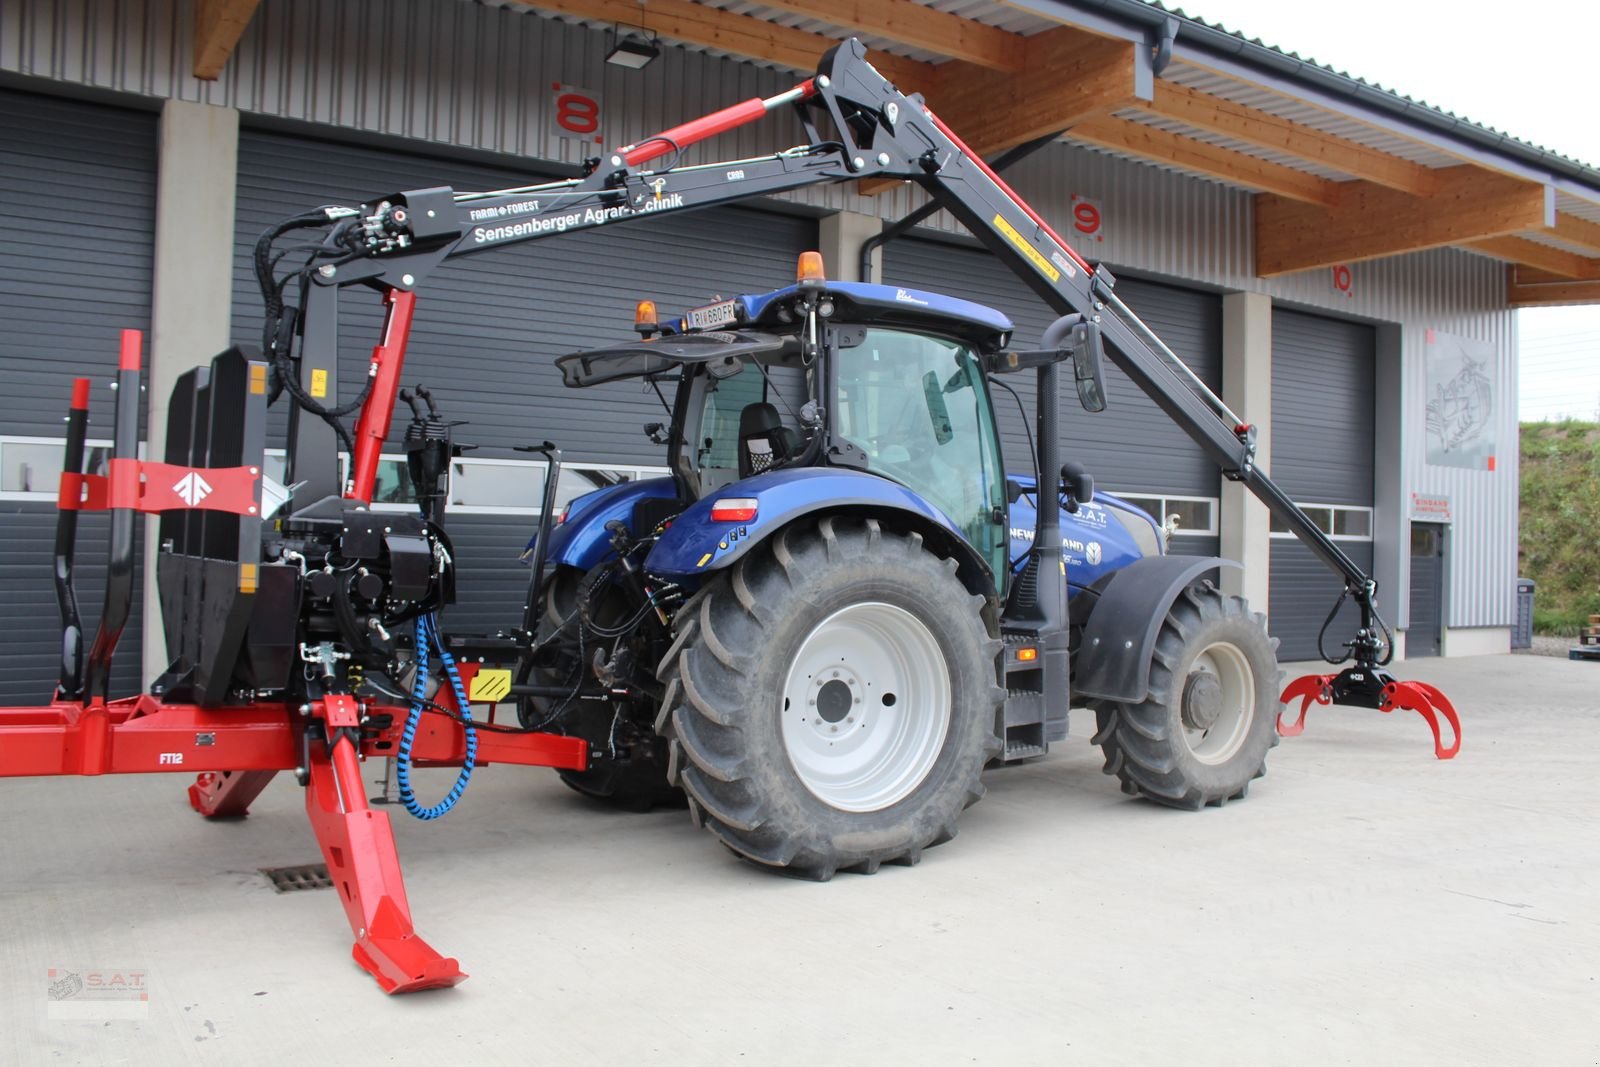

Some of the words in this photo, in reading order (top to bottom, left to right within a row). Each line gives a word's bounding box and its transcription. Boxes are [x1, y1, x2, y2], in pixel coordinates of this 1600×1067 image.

[556, 93, 600, 133] 8
[470, 207, 498, 220] FARMI
[506, 200, 539, 214] FOREST
[474, 213, 581, 243] Sensenberger
[584, 193, 684, 224] Agrar-chnik
[1074, 203, 1101, 234] 9
[1332, 265, 1352, 291] 10
[1009, 527, 1035, 541] NEW
[159, 752, 183, 765] FT12
